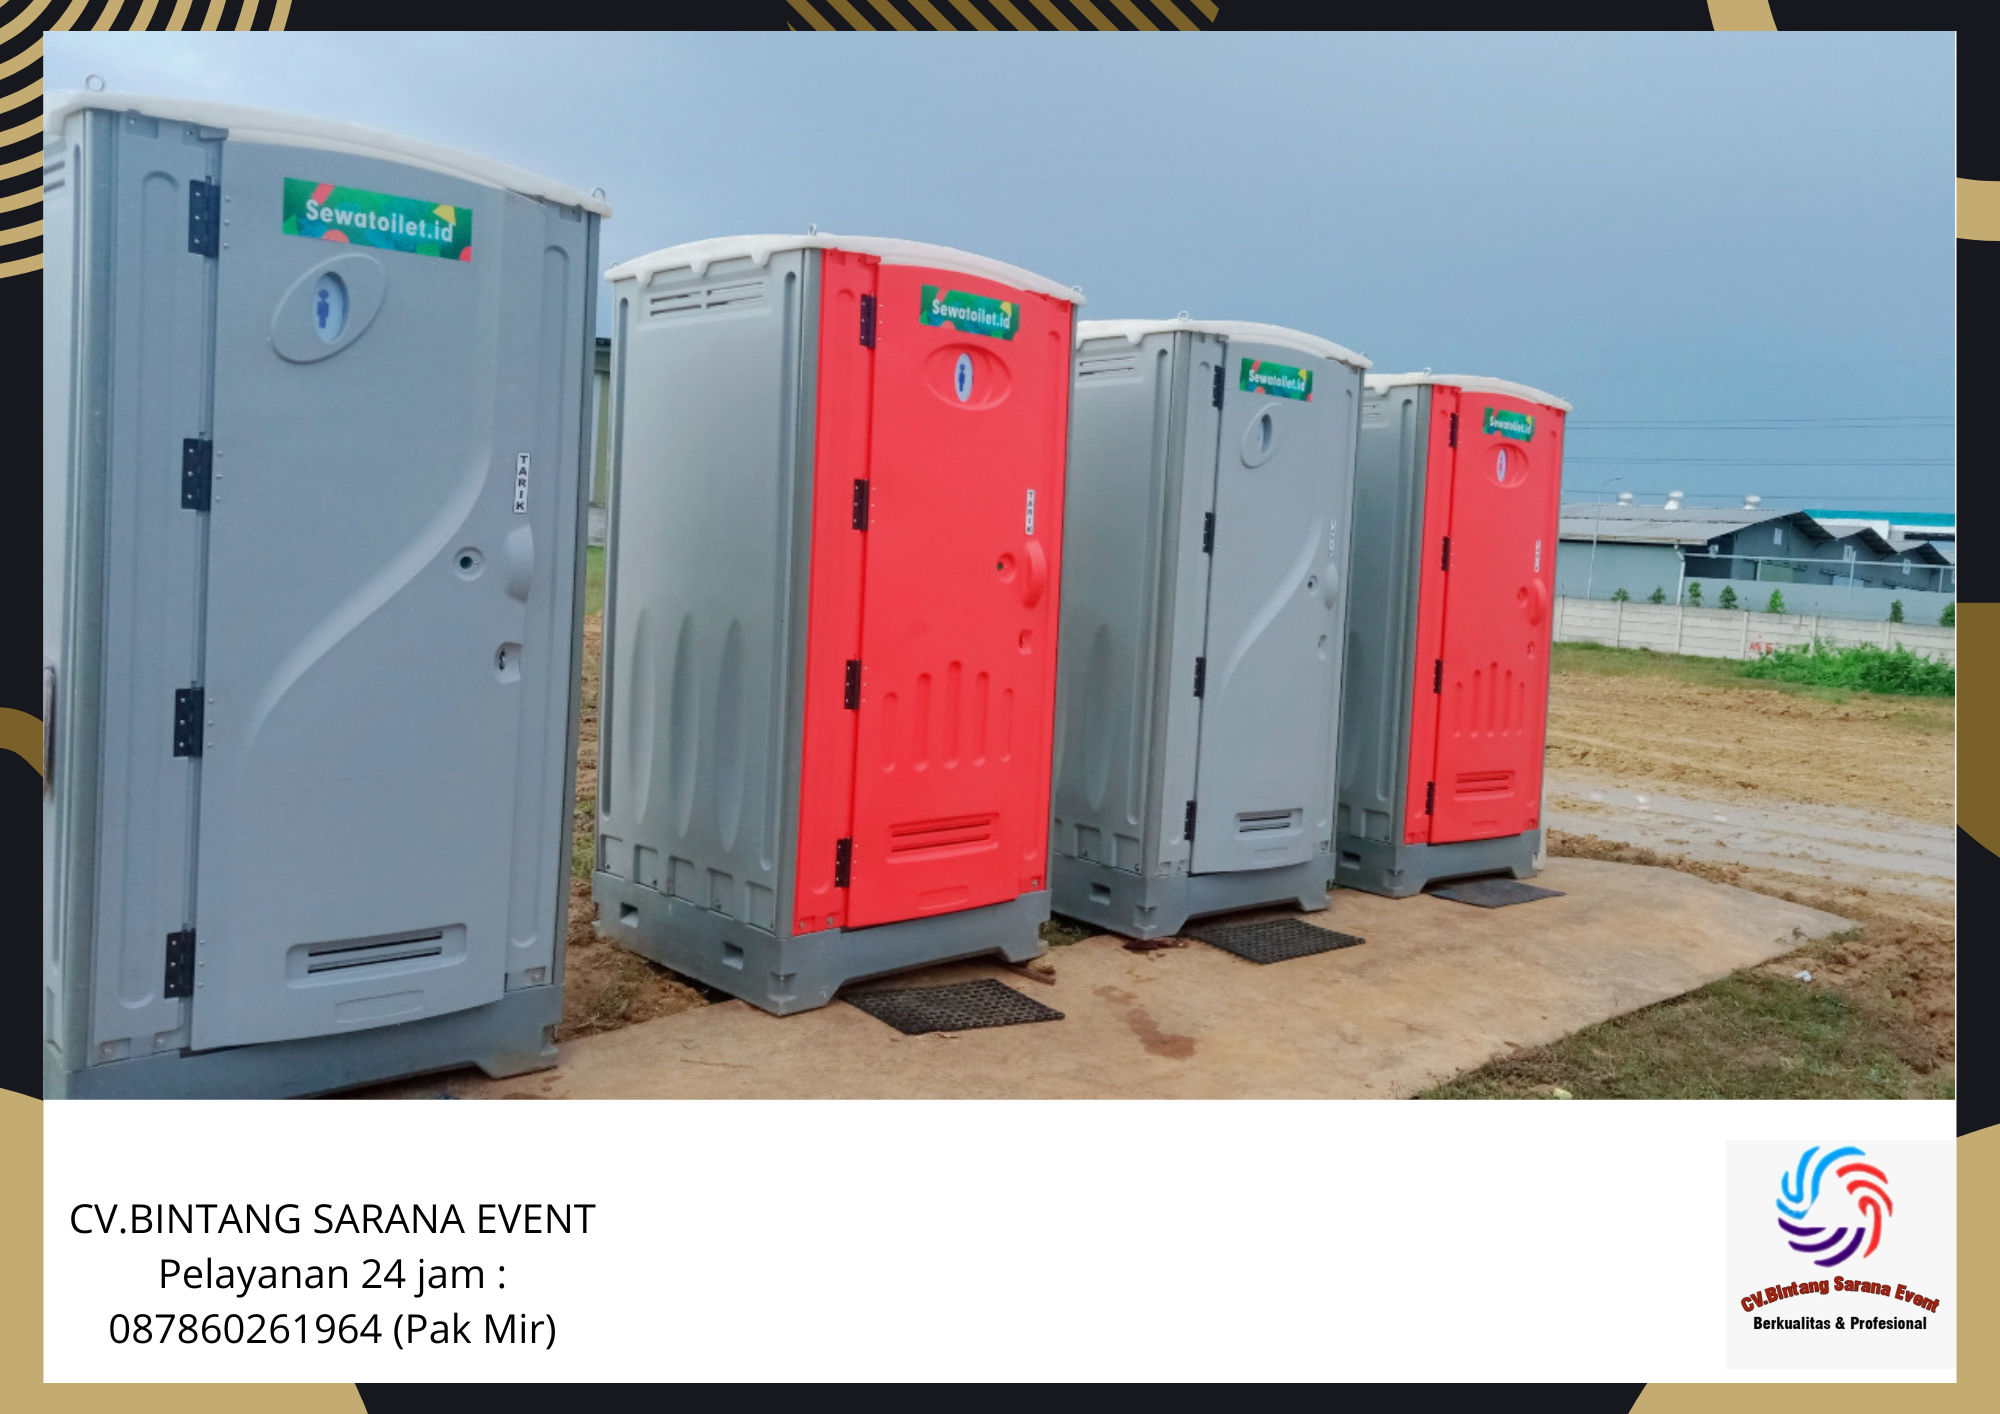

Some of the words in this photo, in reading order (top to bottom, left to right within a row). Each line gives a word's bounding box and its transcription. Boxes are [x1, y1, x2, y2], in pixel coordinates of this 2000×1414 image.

[305, 198, 454, 243] Sewatoilet.id
[932, 298, 1012, 329] Sewatoilet.id
[1248, 369, 1306, 392] Sewatoilet.id
[516, 455, 529, 510] TARIK
